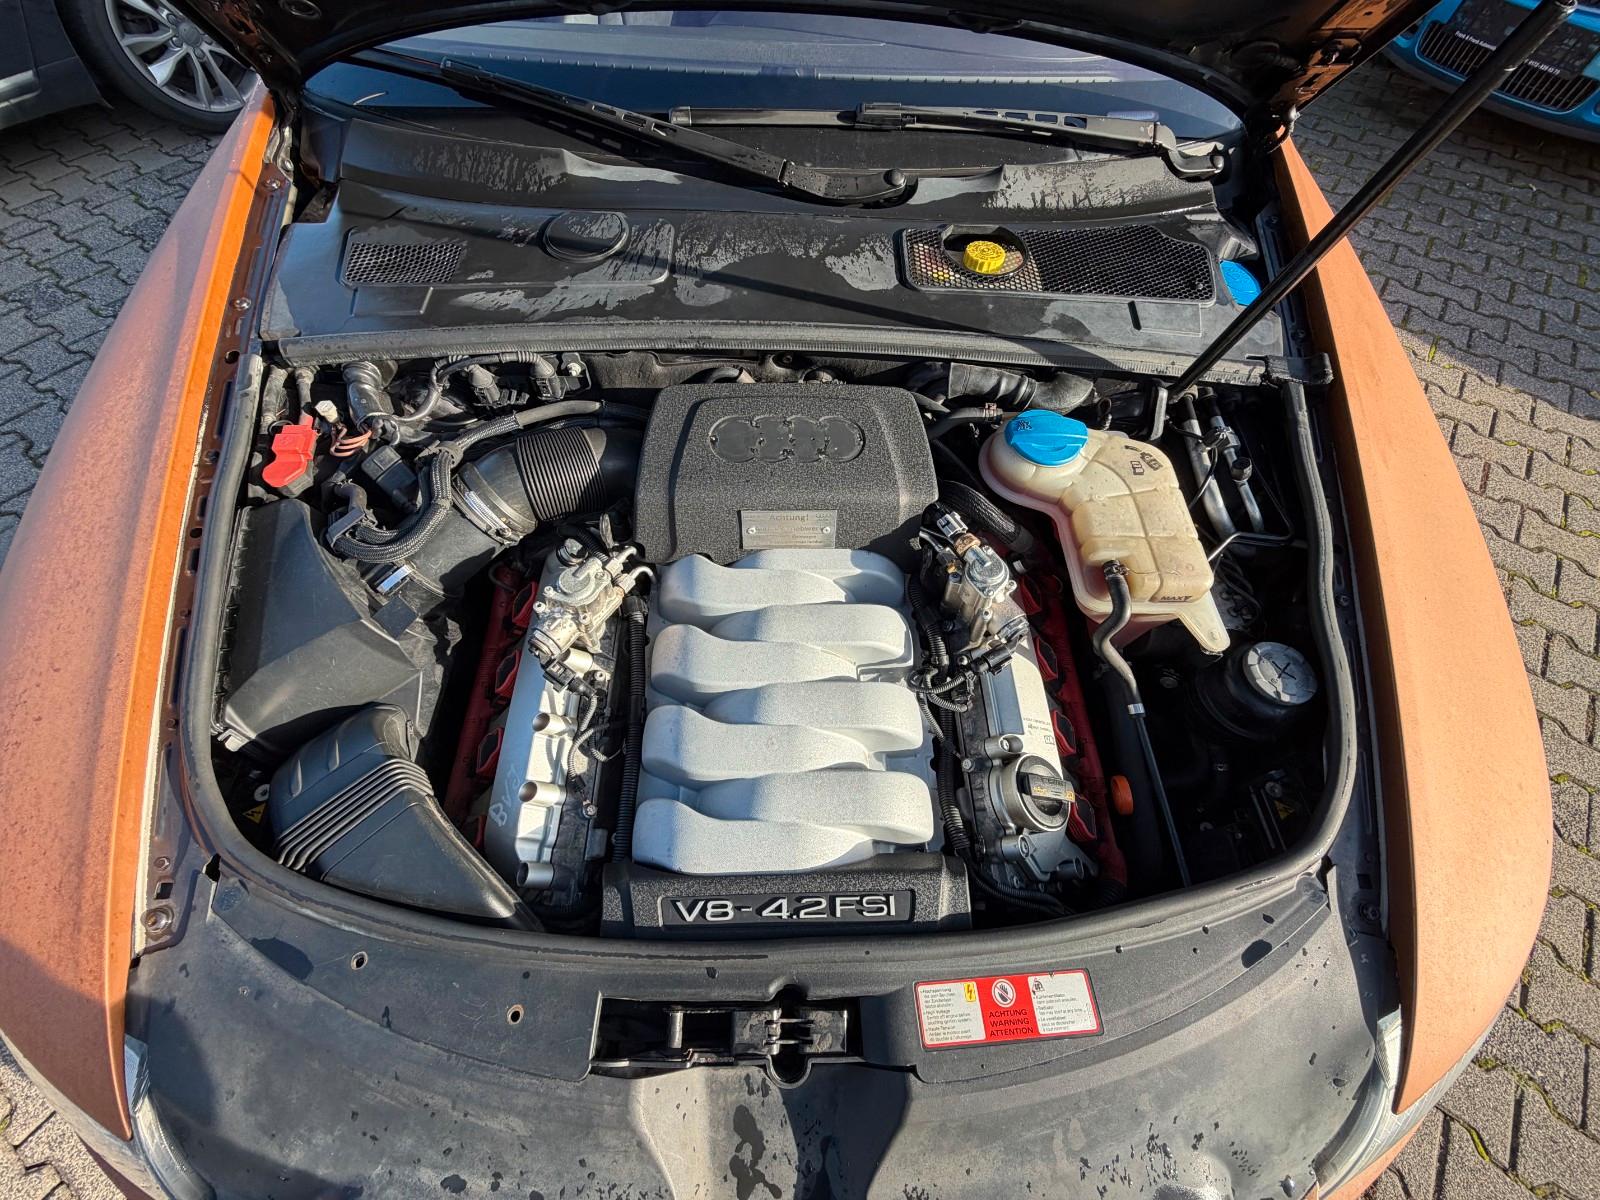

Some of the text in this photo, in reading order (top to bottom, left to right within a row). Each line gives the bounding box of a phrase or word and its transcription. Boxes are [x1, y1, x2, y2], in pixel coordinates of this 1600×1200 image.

[769, 514, 809, 522] Achtung!
[988, 1008, 1028, 1018] ACHTUNG
[989, 1017, 1030, 1027] WARNING
[990, 1027, 1034, 1037] ATTENTION
